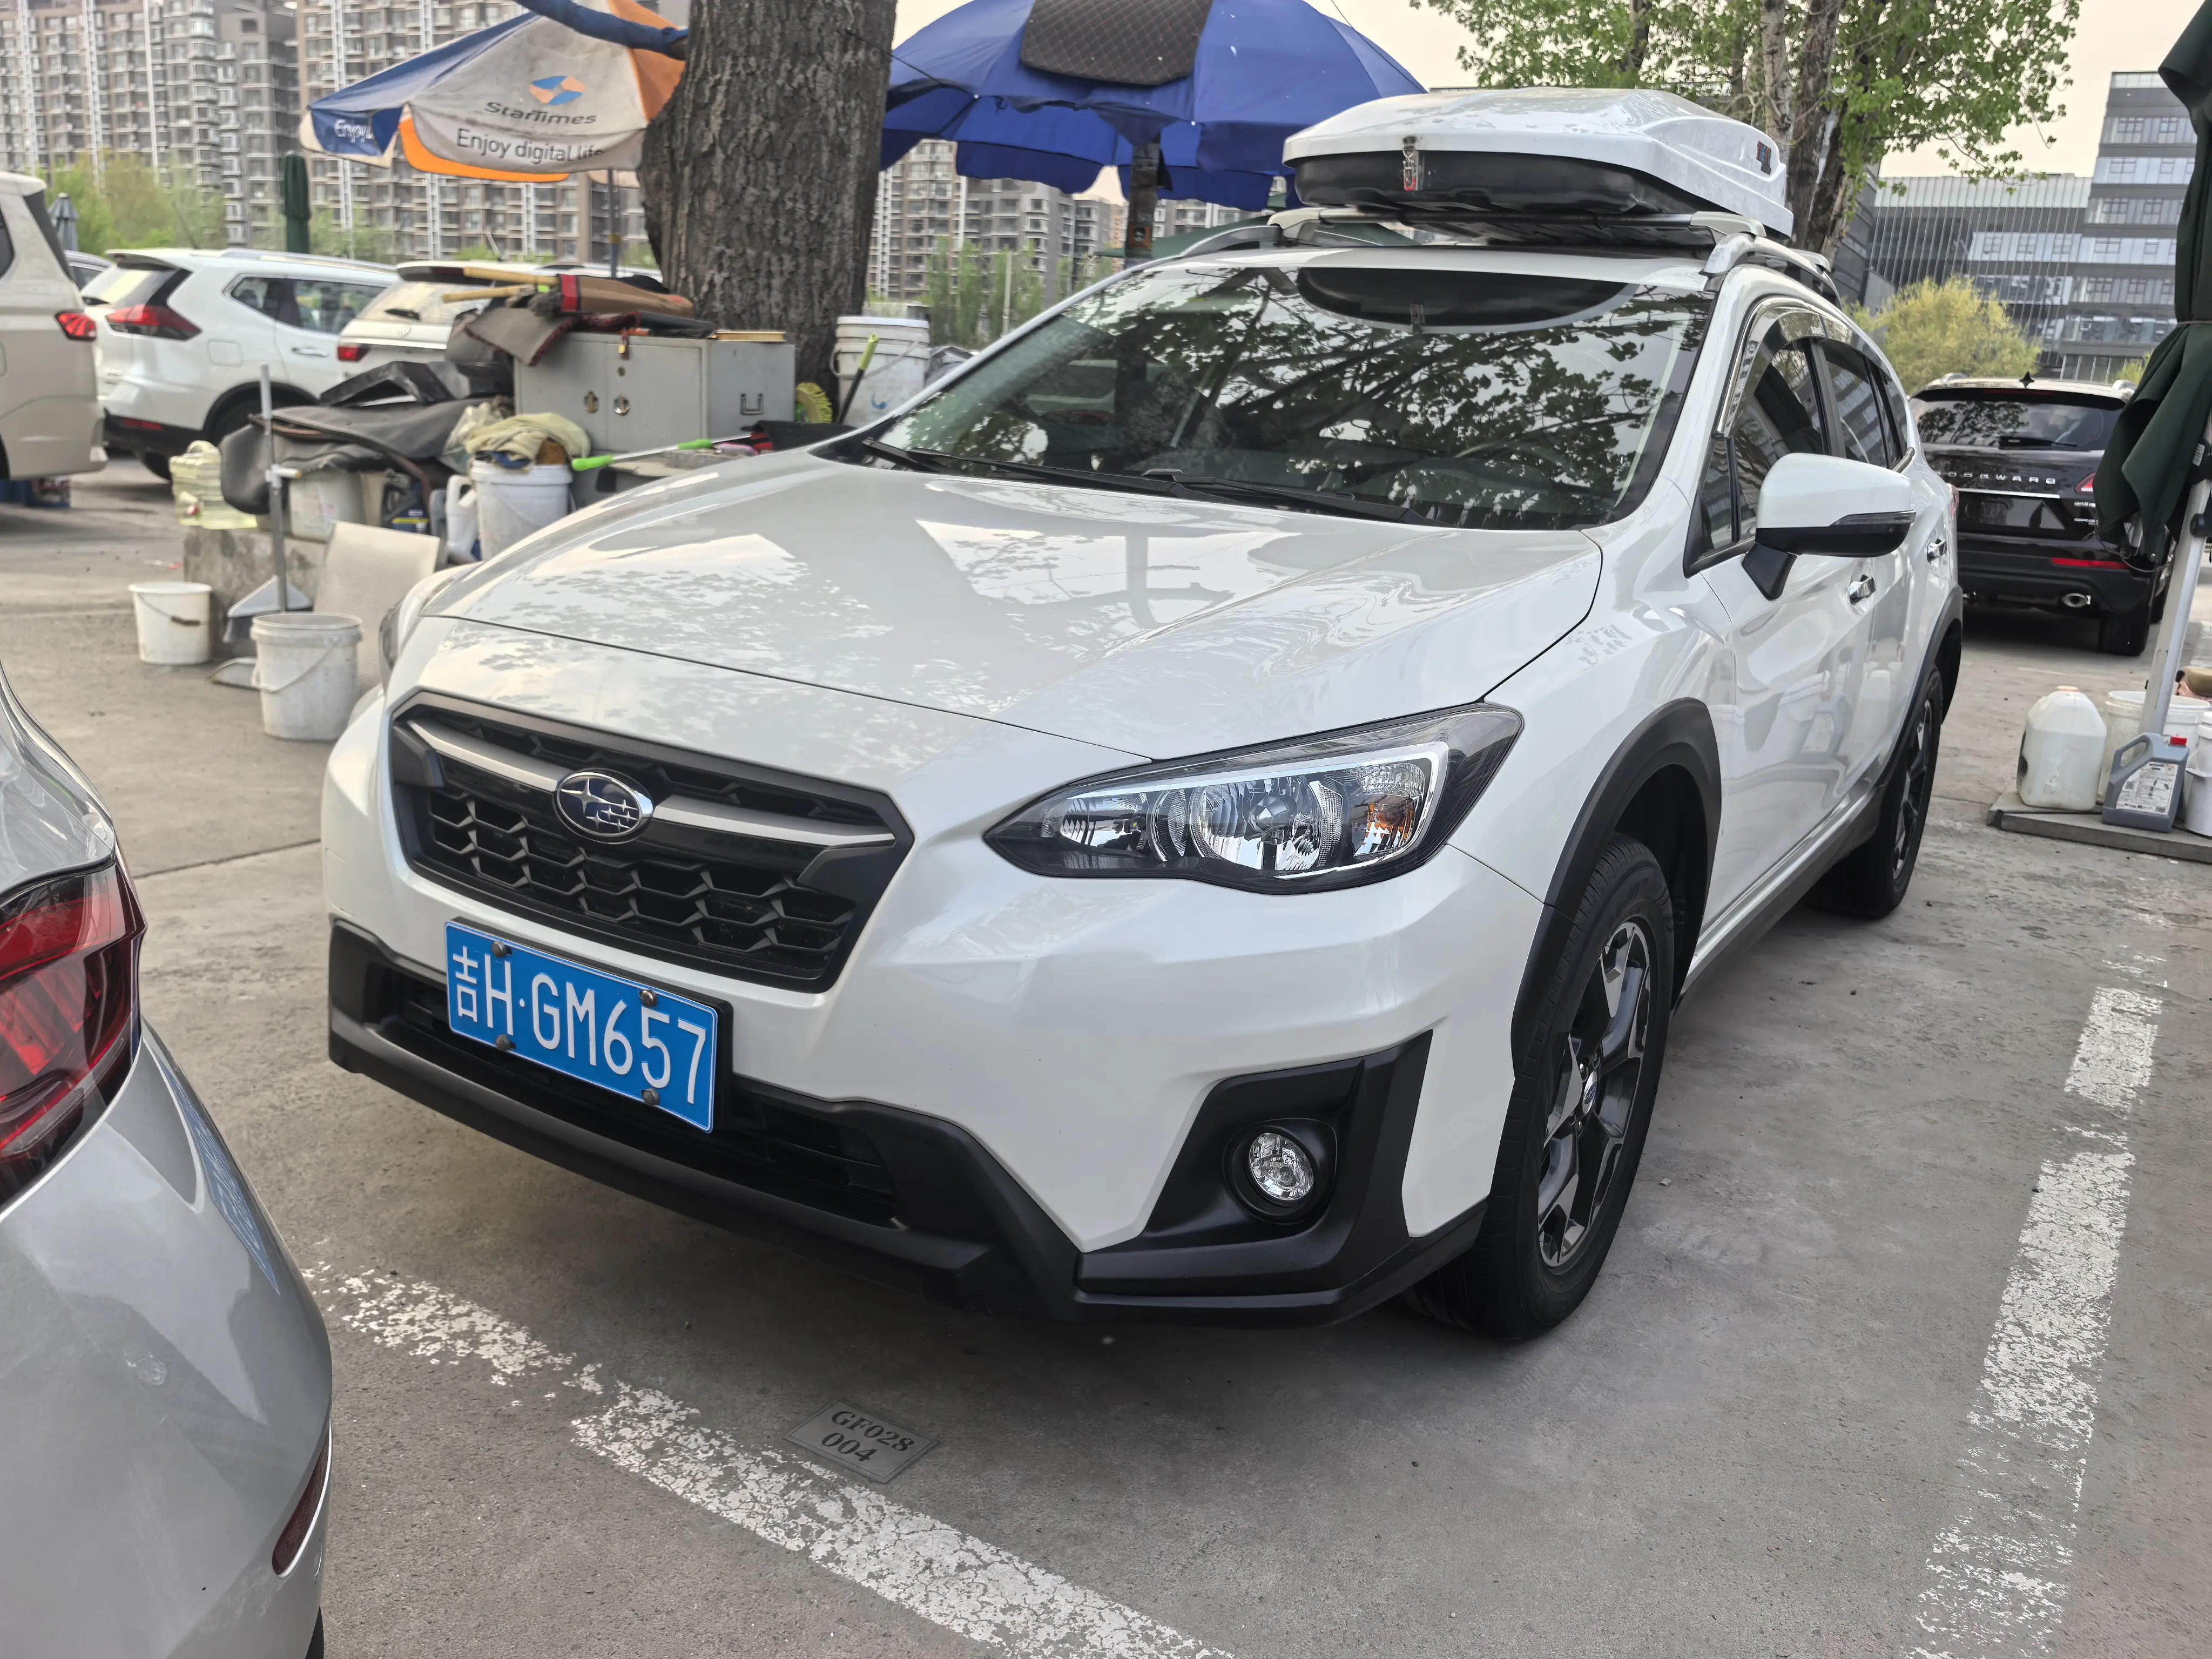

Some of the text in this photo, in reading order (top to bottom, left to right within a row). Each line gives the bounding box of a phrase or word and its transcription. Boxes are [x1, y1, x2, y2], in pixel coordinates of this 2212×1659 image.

[484, 101, 598, 125] StarTimes
[456, 127, 511, 159] Enjoy
[515, 140, 574, 164] digital
[821, 1432, 878, 1462] 004
[831, 1411, 915, 1452] GF028
